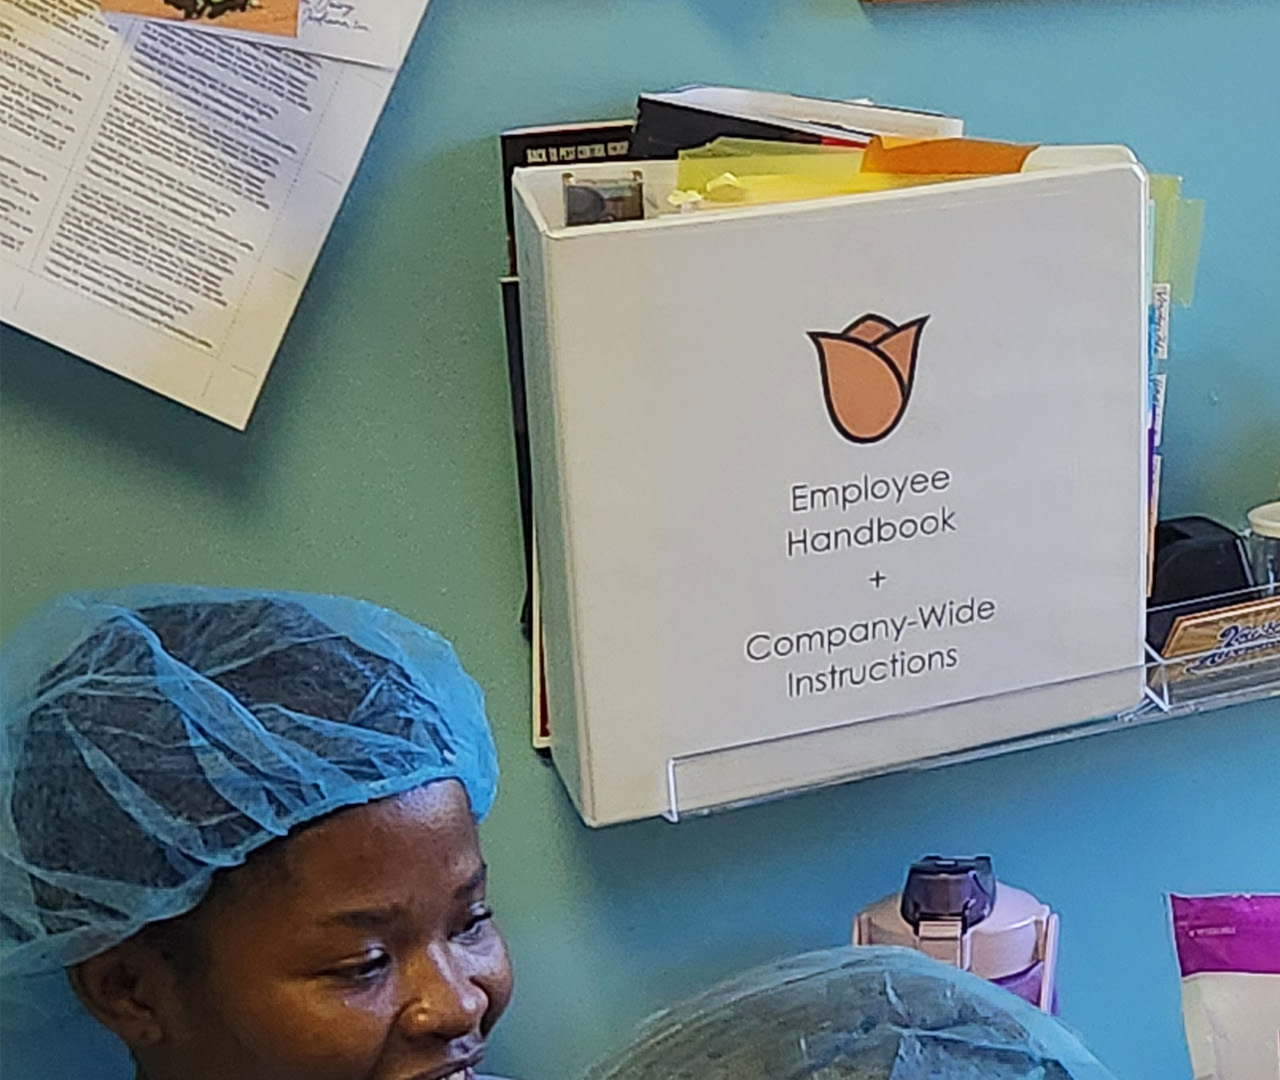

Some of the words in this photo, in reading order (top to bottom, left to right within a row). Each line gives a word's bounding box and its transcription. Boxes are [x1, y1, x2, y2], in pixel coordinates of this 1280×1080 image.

[791, 469, 951, 512] Employee
[786, 506, 957, 556] Handbook
[745, 597, 996, 662] Company-Wide
[787, 648, 958, 697] Instructions
